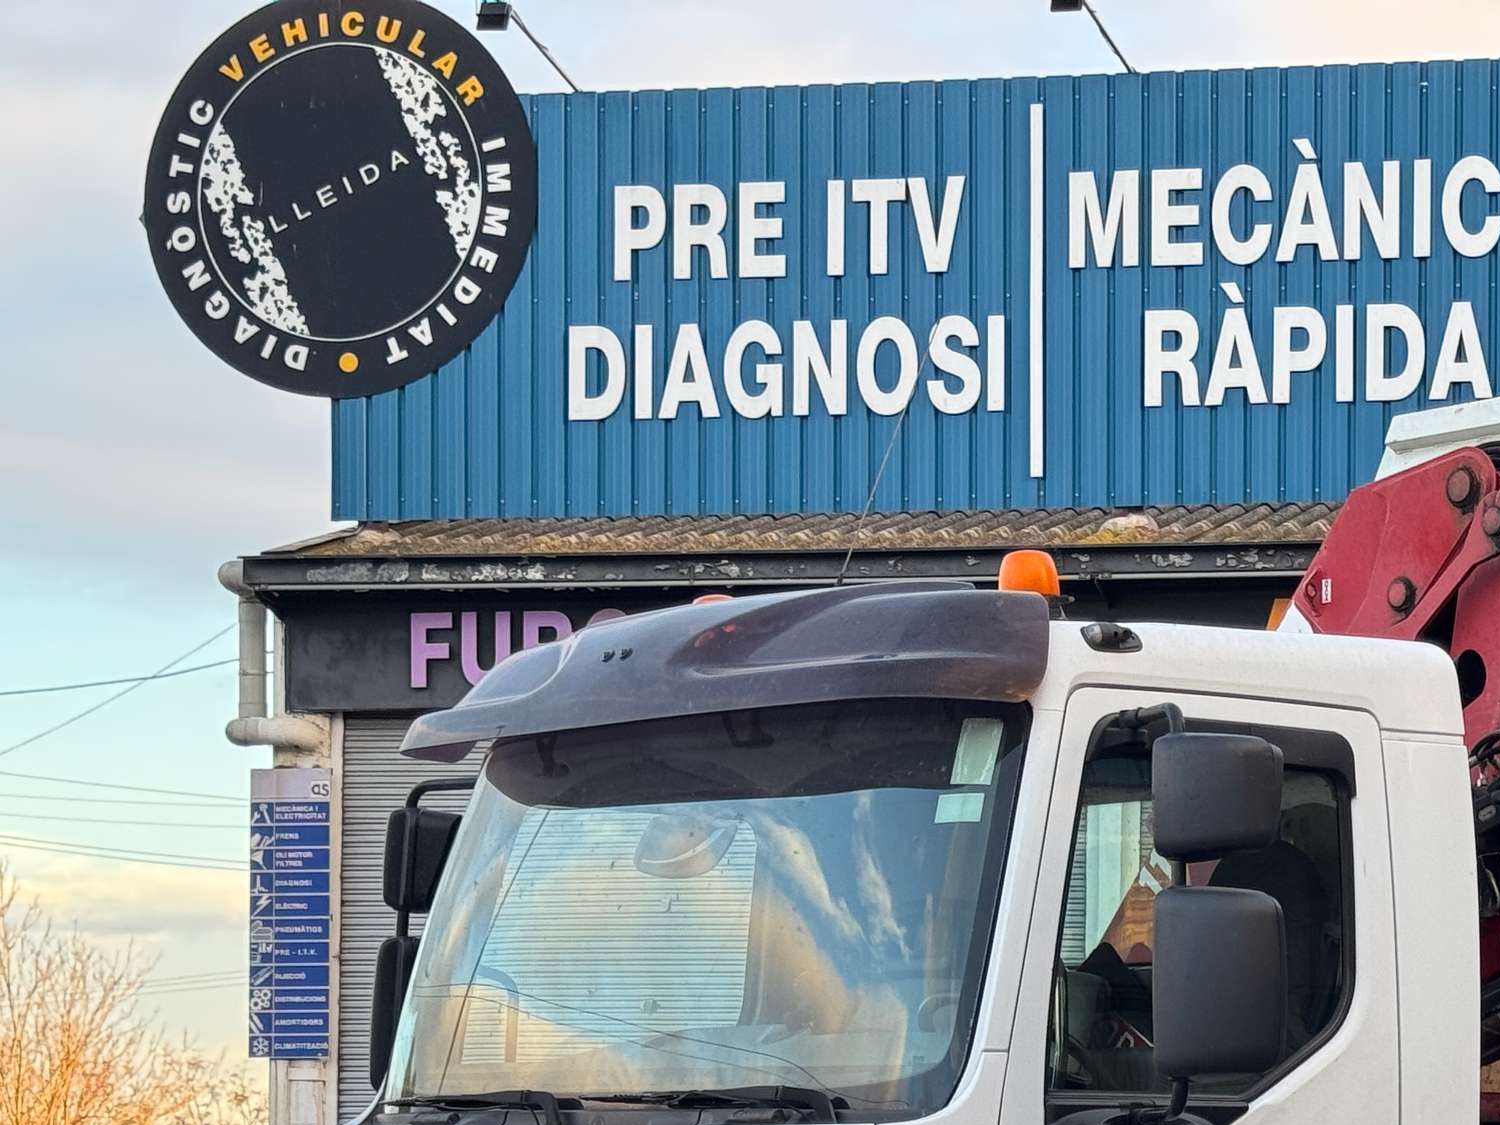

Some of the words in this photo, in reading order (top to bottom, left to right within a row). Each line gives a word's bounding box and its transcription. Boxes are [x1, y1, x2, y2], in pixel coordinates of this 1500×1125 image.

[218, 11, 486, 107] VEHICULAR
[166, 99, 310, 371] DIAGNÒSTIC
[267, 149, 410, 234] LLEIDA
[613, 180, 788, 281] PRE
[826, 175, 967, 277] ITV
[385, 136, 513, 365] IMMEDIAT
[567, 314, 1006, 421] DIAGNOSI
[1143, 281, 1494, 407] RÀPIDA
[275, 832, 300, 840] FRENS
